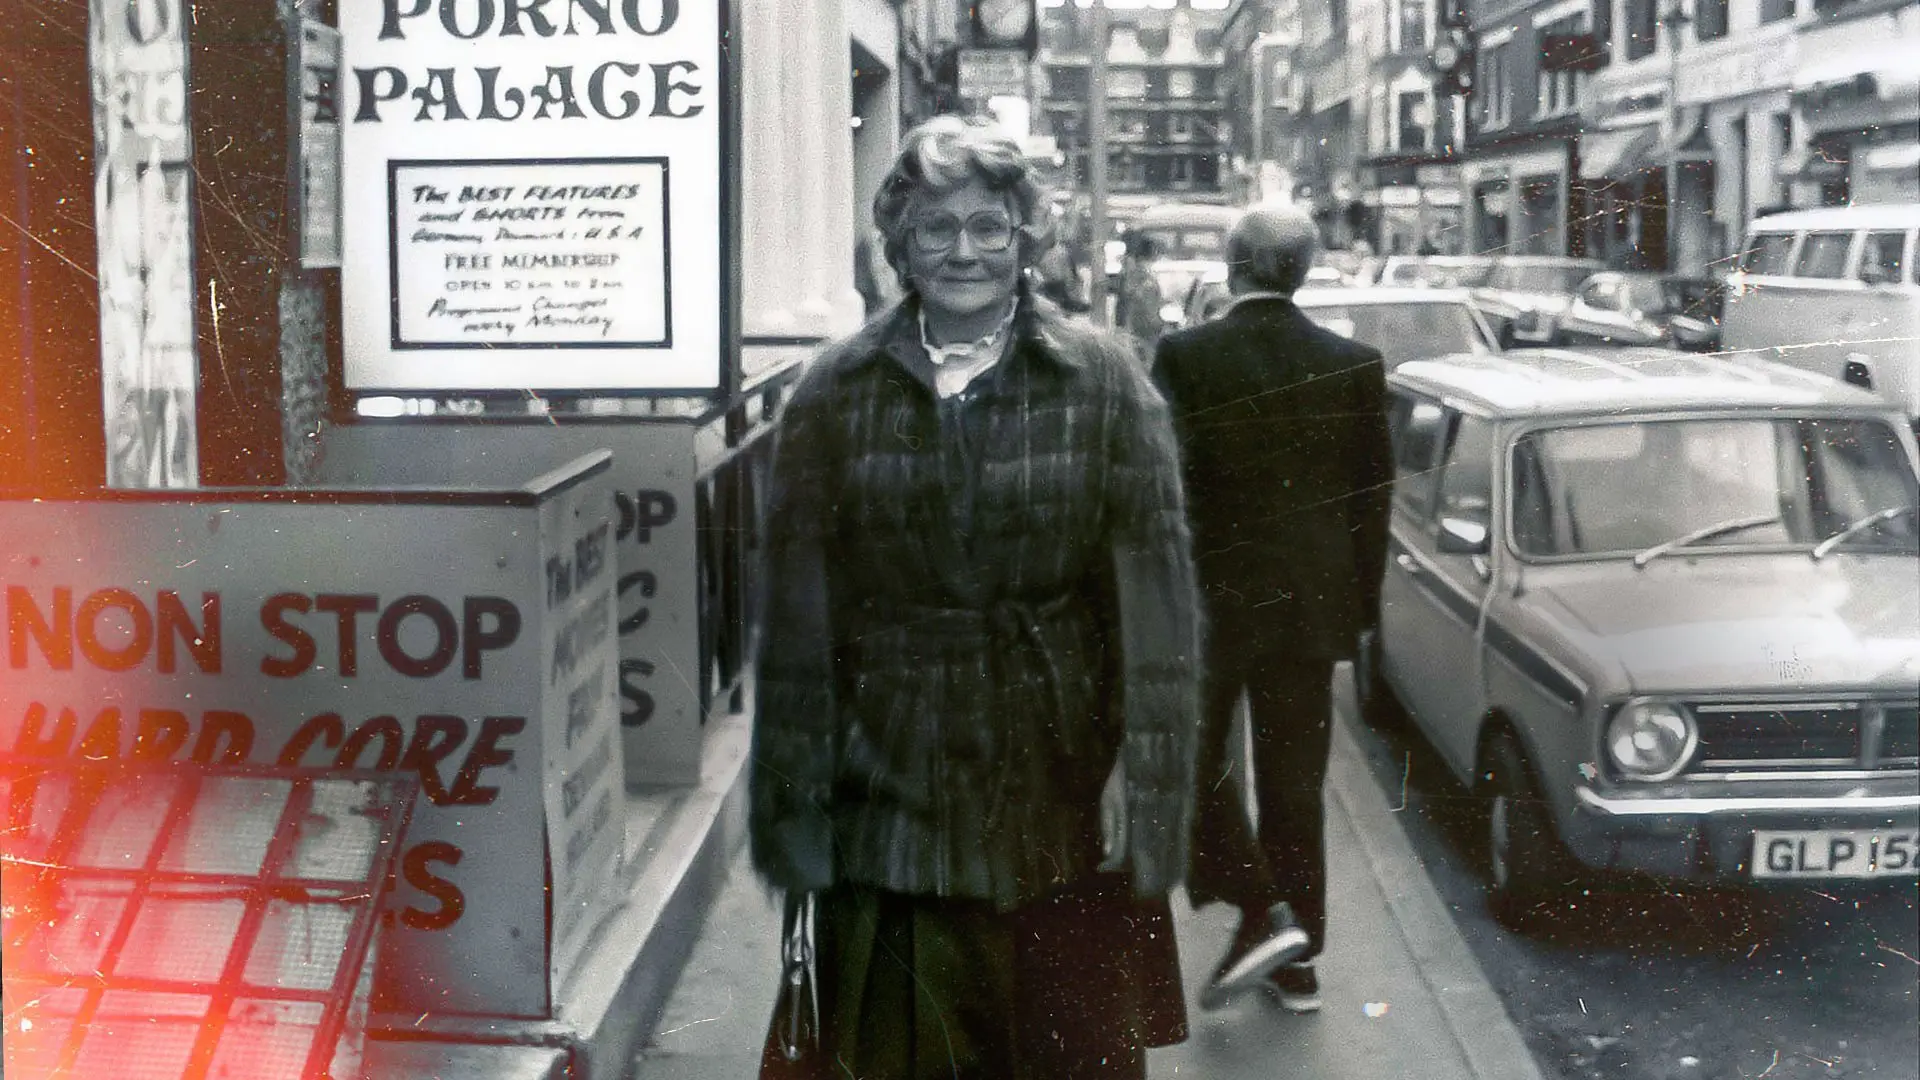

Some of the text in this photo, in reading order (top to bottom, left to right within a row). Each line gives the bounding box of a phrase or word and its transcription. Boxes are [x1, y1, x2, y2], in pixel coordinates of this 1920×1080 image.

[378, 0, 680, 39] PORNO
[352, 60, 705, 123] PALACE
[412, 184, 640, 203] The BEST FEATURES
[444, 253, 620, 270] FREE MEMBERSHIP
[7, 584, 222, 674] NON
[260, 592, 522, 680] STOP
[1768, 838, 1855, 872] GLP
